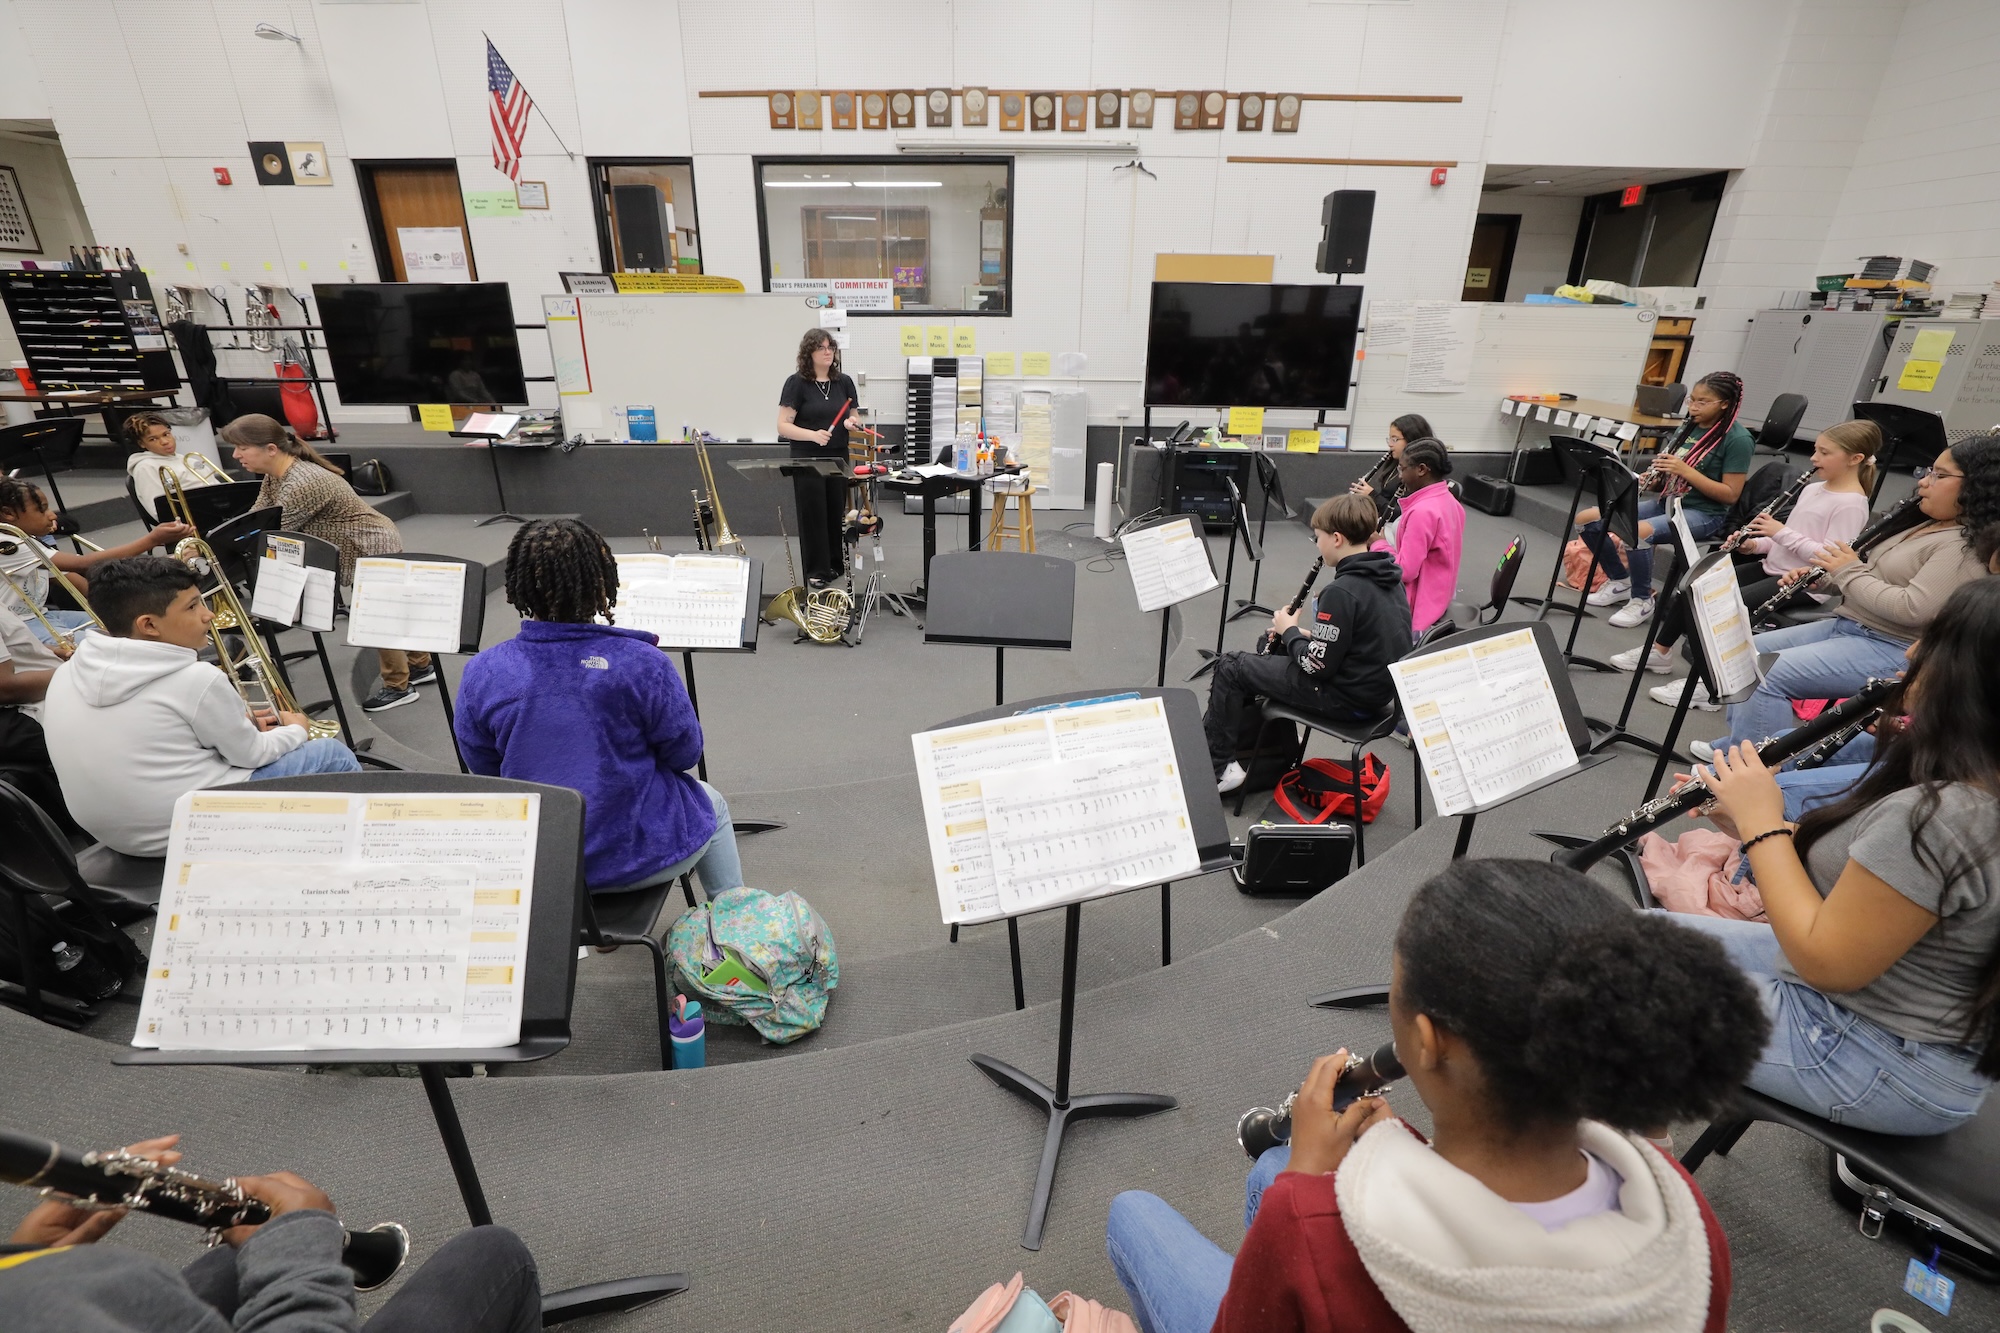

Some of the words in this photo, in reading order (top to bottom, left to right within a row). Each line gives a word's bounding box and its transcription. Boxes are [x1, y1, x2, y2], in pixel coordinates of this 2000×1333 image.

[1623, 185, 1642, 206] EXIT
[834, 281, 889, 289] COMMITMENT
[552, 300, 571, 313] 2/7
[584, 302, 619, 323] Progress
[621, 301, 655, 316] Reports
[277, 541, 300, 550] ESSENTIAL
[277, 547, 300, 556] ELEMENTS
[162, 970, 169, 978] G
